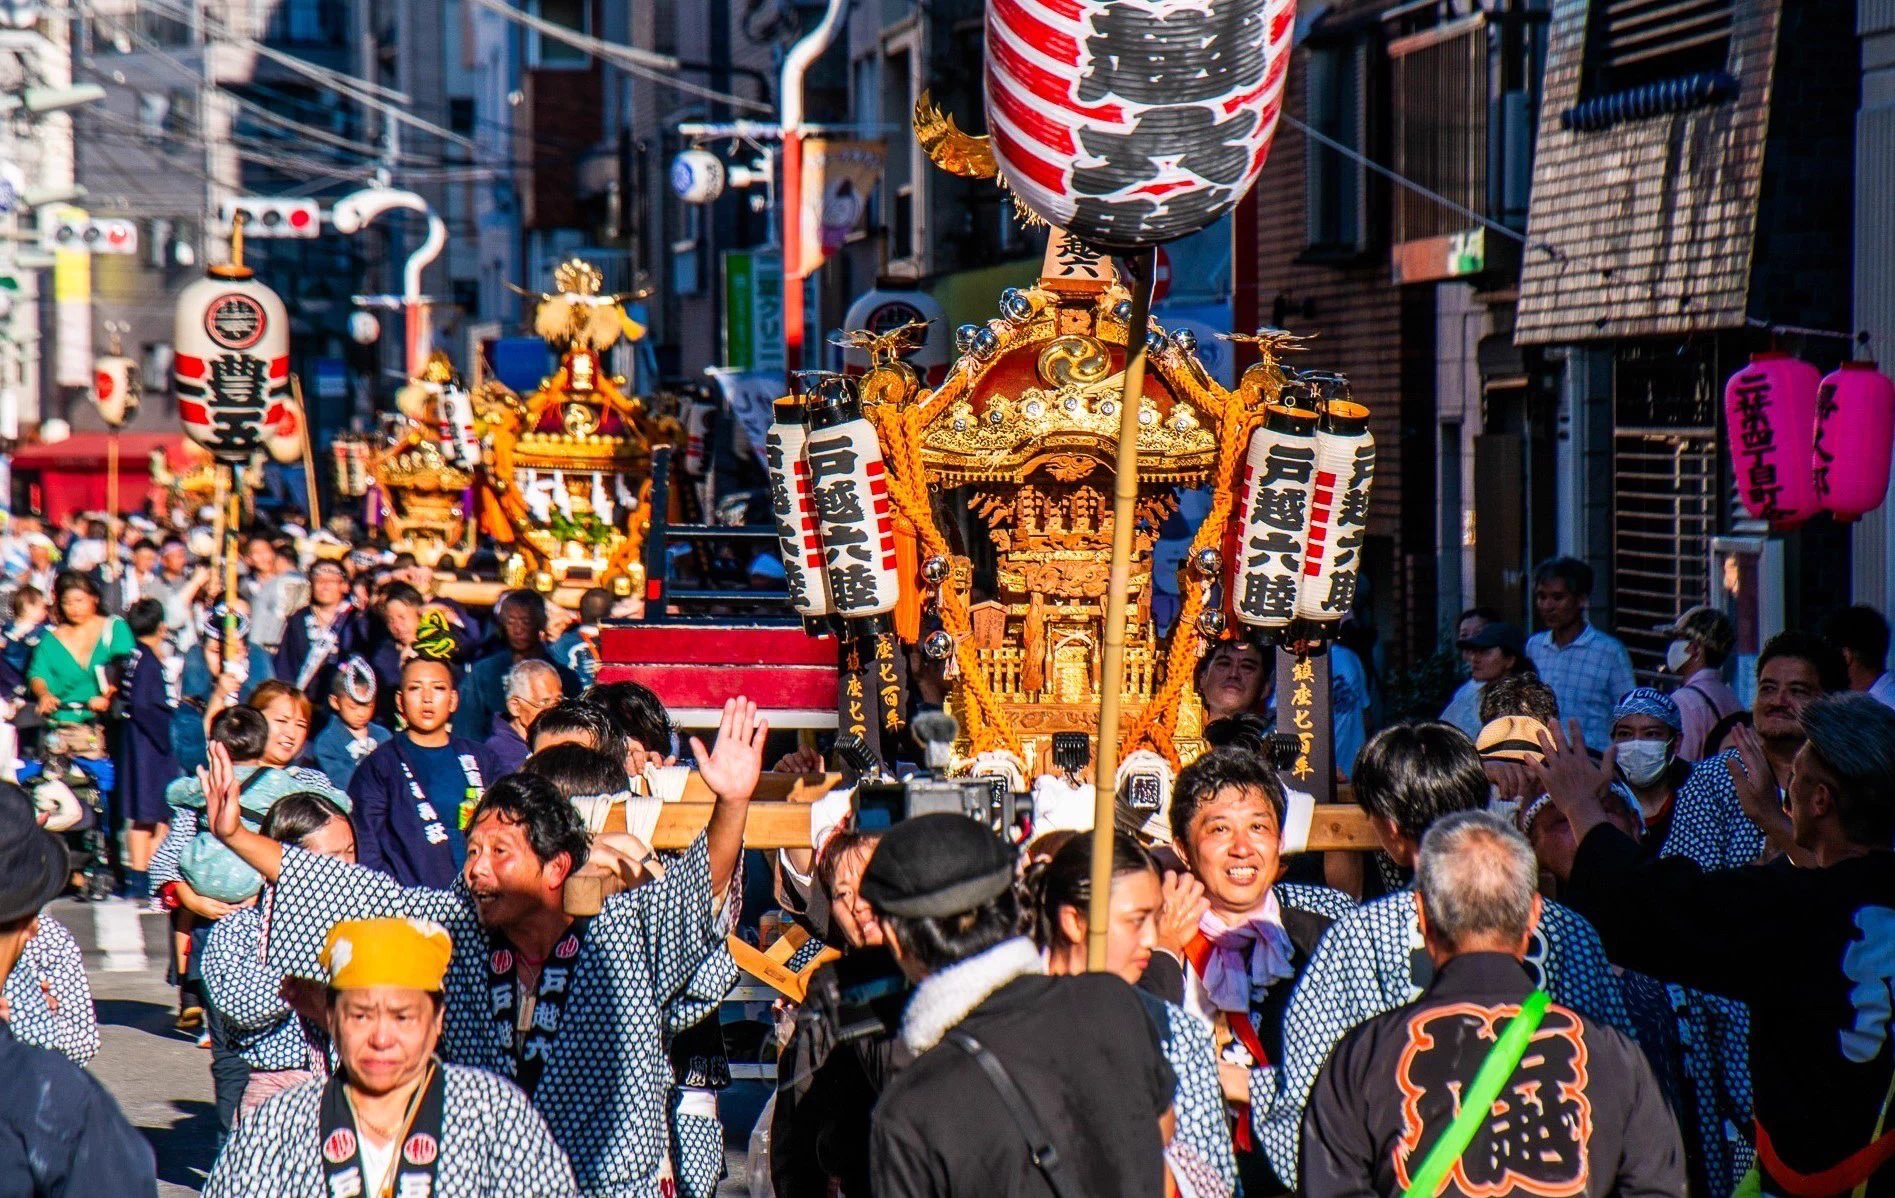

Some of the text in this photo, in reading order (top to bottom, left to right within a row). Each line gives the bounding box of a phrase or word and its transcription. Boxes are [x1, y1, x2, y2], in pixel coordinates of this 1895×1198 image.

[808, 435, 881, 611] 戸越六睦
[1239, 443, 1316, 619] 戸越六睦
